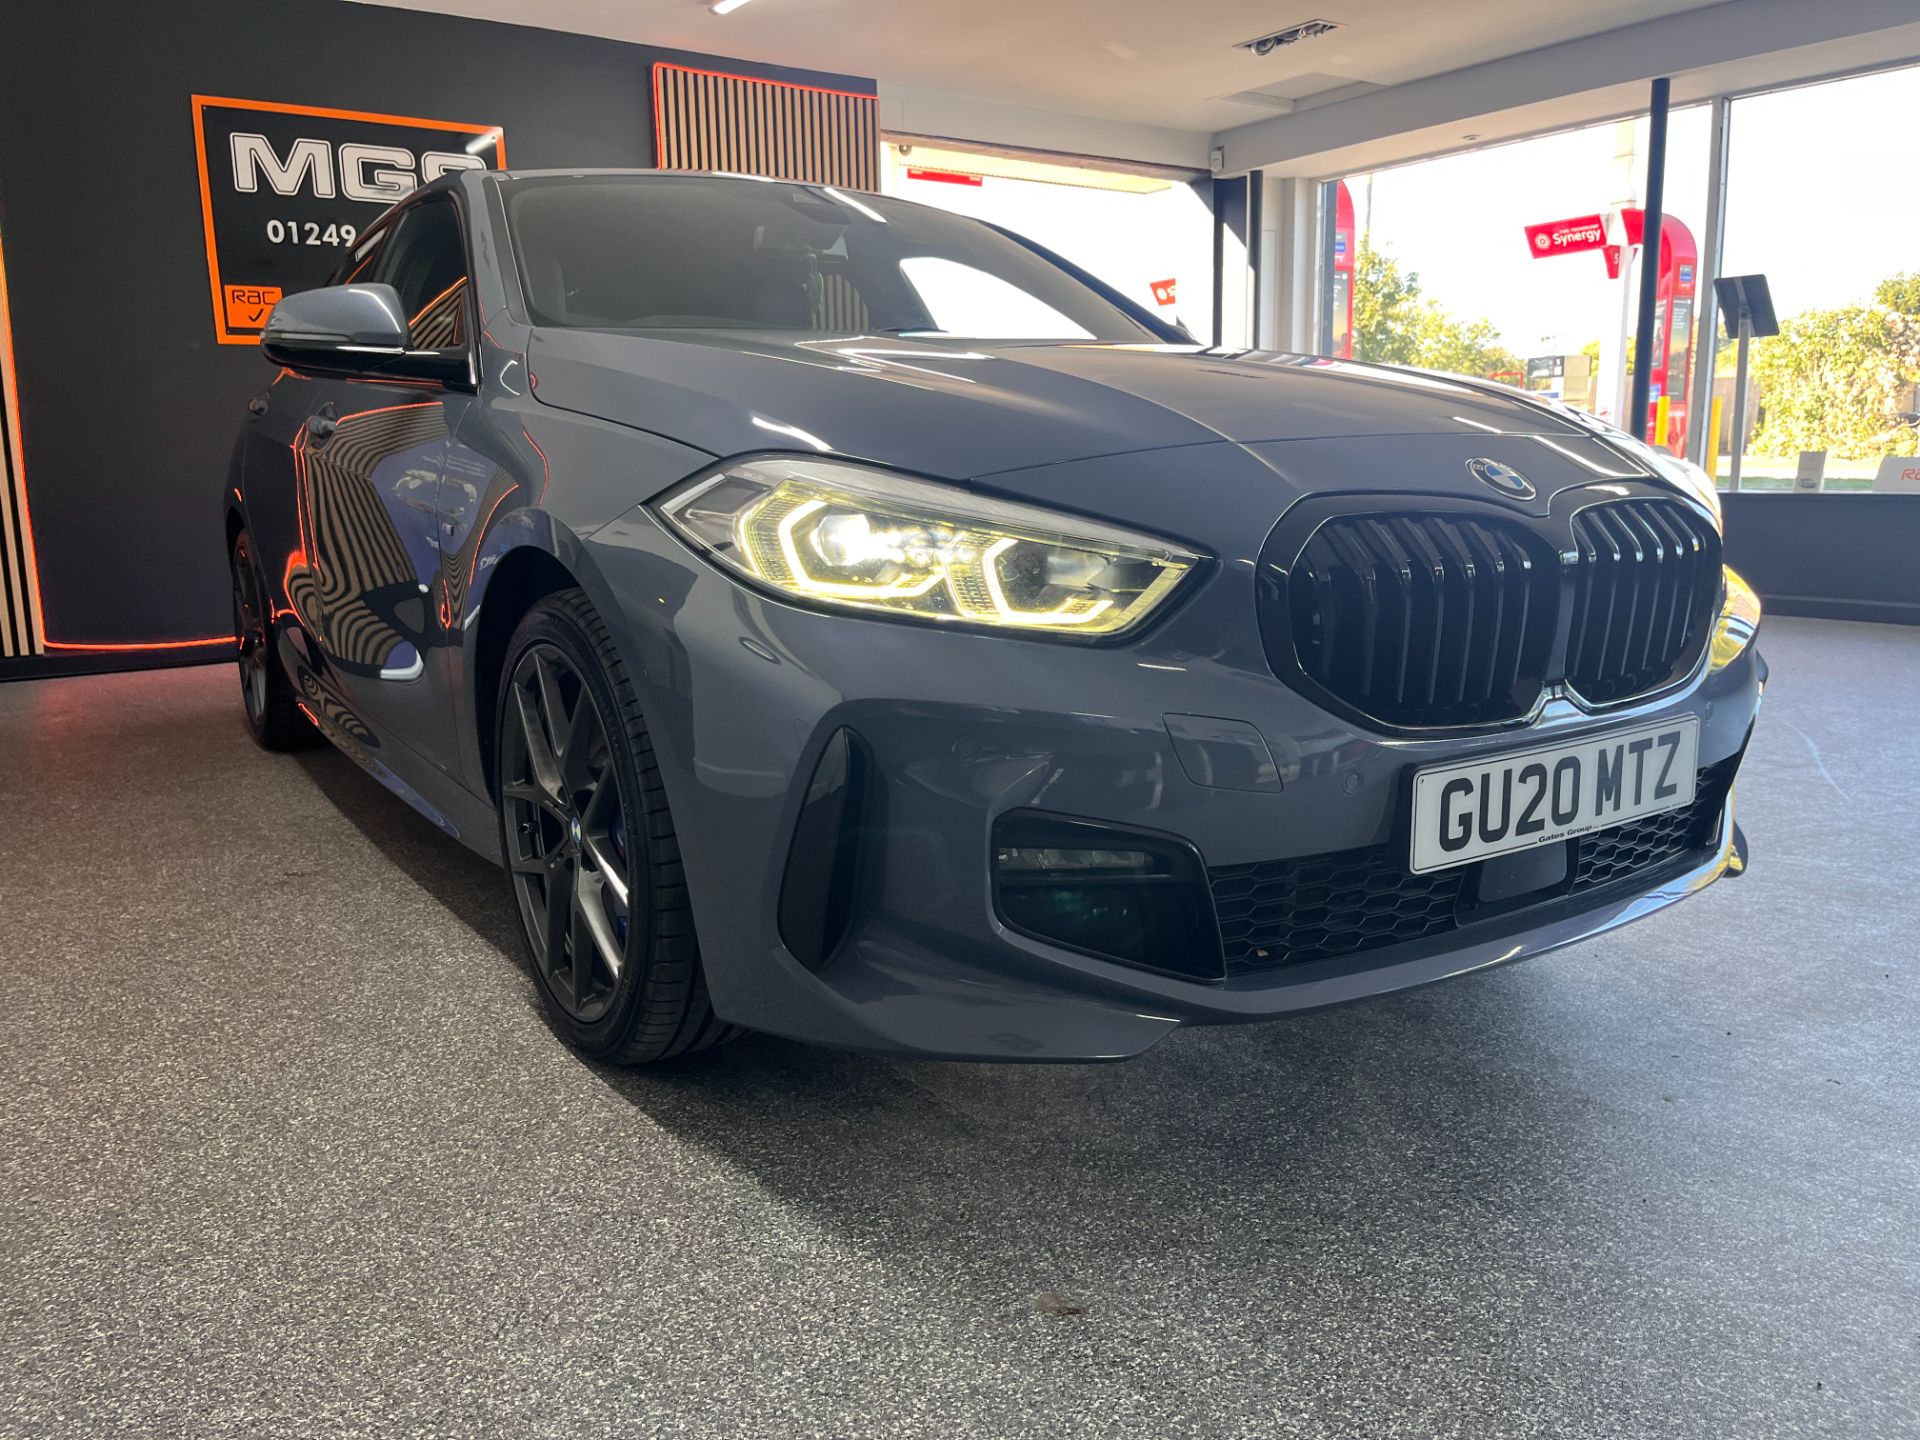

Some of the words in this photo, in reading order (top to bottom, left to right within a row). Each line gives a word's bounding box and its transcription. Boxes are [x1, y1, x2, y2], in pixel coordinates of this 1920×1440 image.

[266, 219, 357, 248] 01249
[1552, 229, 1601, 247] Synergy
[1438, 755, 1582, 853] GU20
[1594, 730, 1682, 817] MTZ
[1538, 831, 1565, 843] Gates
[1566, 824, 1593, 837] Group
